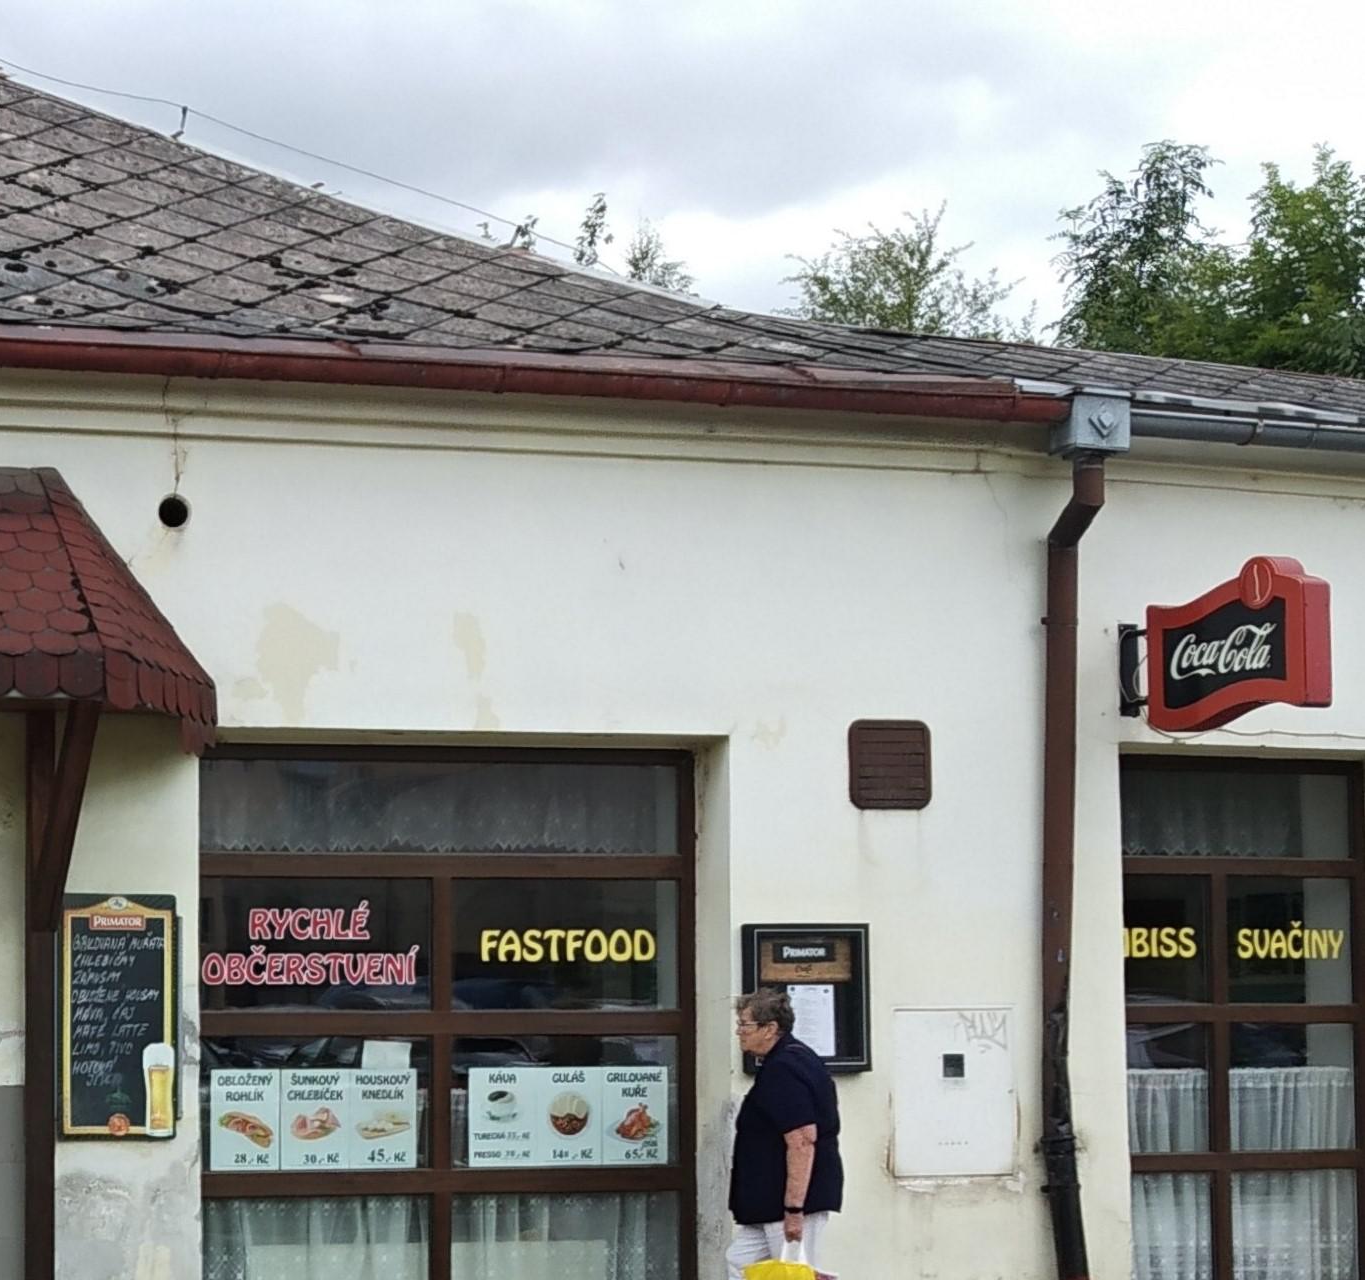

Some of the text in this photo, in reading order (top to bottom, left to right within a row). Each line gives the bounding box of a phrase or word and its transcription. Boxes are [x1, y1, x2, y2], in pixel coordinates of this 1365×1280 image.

[1170, 622, 1277, 680] Coca-Cola
[93, 916, 142, 928] PRIMATOR
[249, 900, 370, 940] RYCHLÉ
[480, 928, 657, 963] FASTFOOD
[1237, 920, 1345, 960] SVAČINY
[202, 945, 420, 985] OBČERSTVENÍ
[217, 1073, 274, 1087] OBLOŽENÝ
[290, 1073, 341, 1086] ŠUNKOVÝ
[355, 1073, 411, 1086] HOUSKOVÝ
[488, 1071, 517, 1084] KÁVA
[552, 1070, 586, 1083] GULÁŠ
[606, 1070, 663, 1083] GRILOVANÉ
[225, 1090, 264, 1102] ROHLÍK
[286, 1087, 343, 1101] CHLEBÍČEK
[361, 1088, 404, 1100] KNEDLÍK
[621, 1085, 648, 1098] KUŘE
[257, 1153, 269, 1164] Kč
[327, 1153, 340, 1163] Kč
[394, 1151, 406, 1162] Kč
[646, 1148, 658, 1159] Kč
